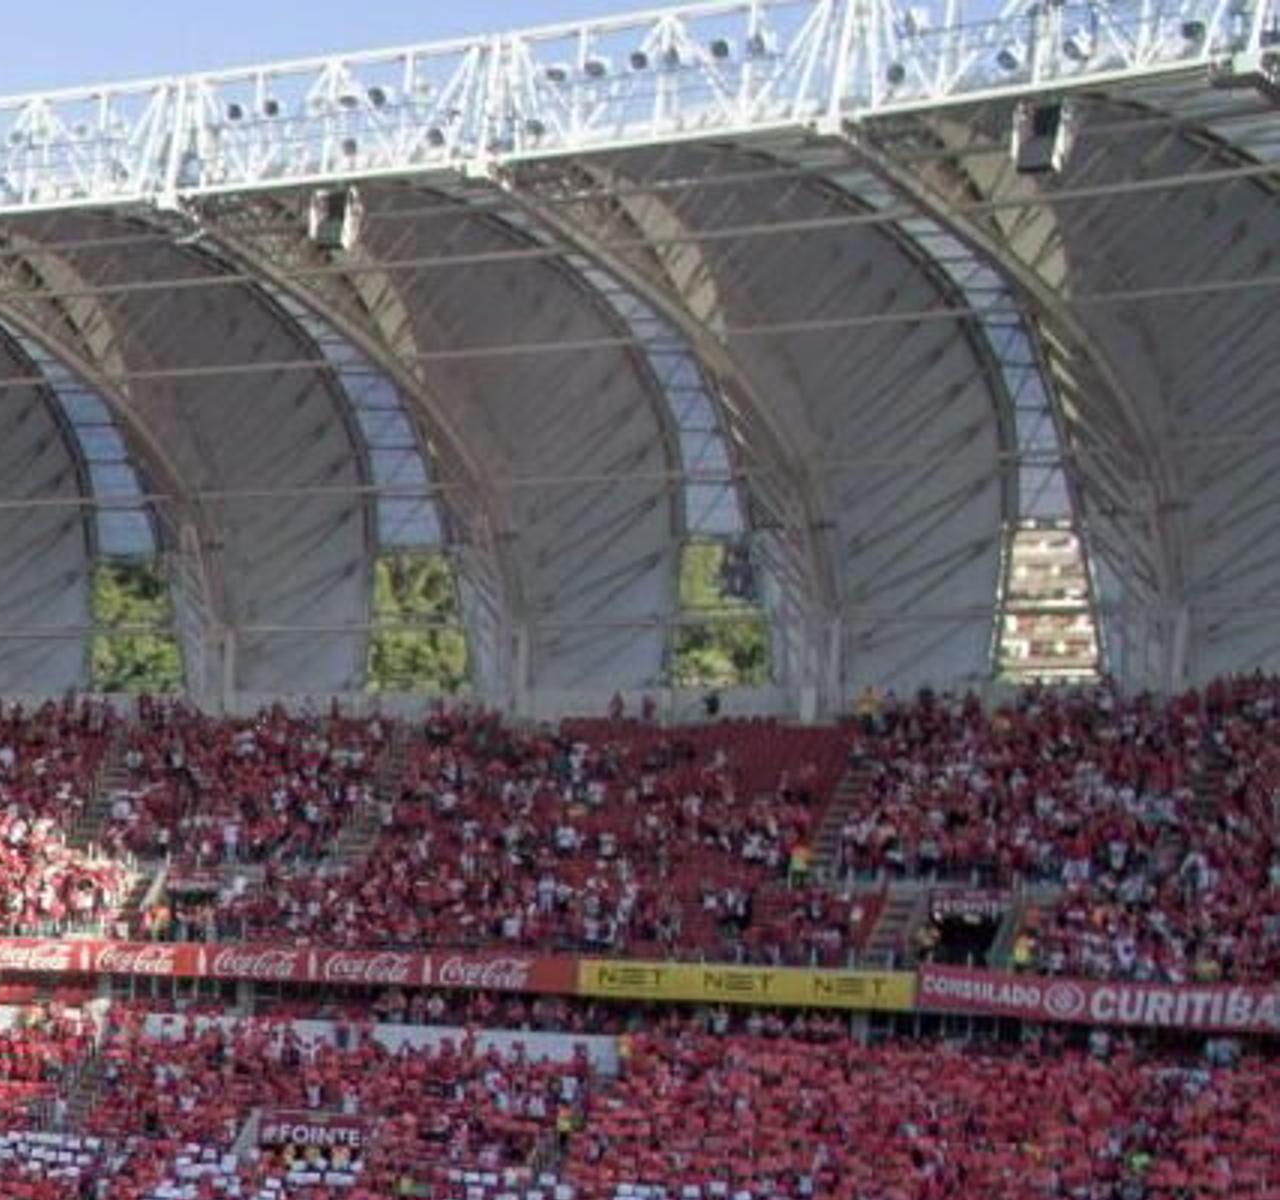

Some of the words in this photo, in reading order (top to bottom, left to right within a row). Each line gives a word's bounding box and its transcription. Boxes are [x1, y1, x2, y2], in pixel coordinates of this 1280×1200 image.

[96, 946, 182, 973] Coca-Cola
[212, 949, 298, 977] Coca-Cola
[324, 953, 413, 981] Coca-Cola
[440, 956, 530, 987] Coca-Cola
[598, 968, 663, 987] NET
[703, 972, 775, 992] NET
[812, 977, 888, 997] NET
[922, 974, 1041, 1008] CONSULADO
[1092, 987, 1280, 1028] CURITIBA
